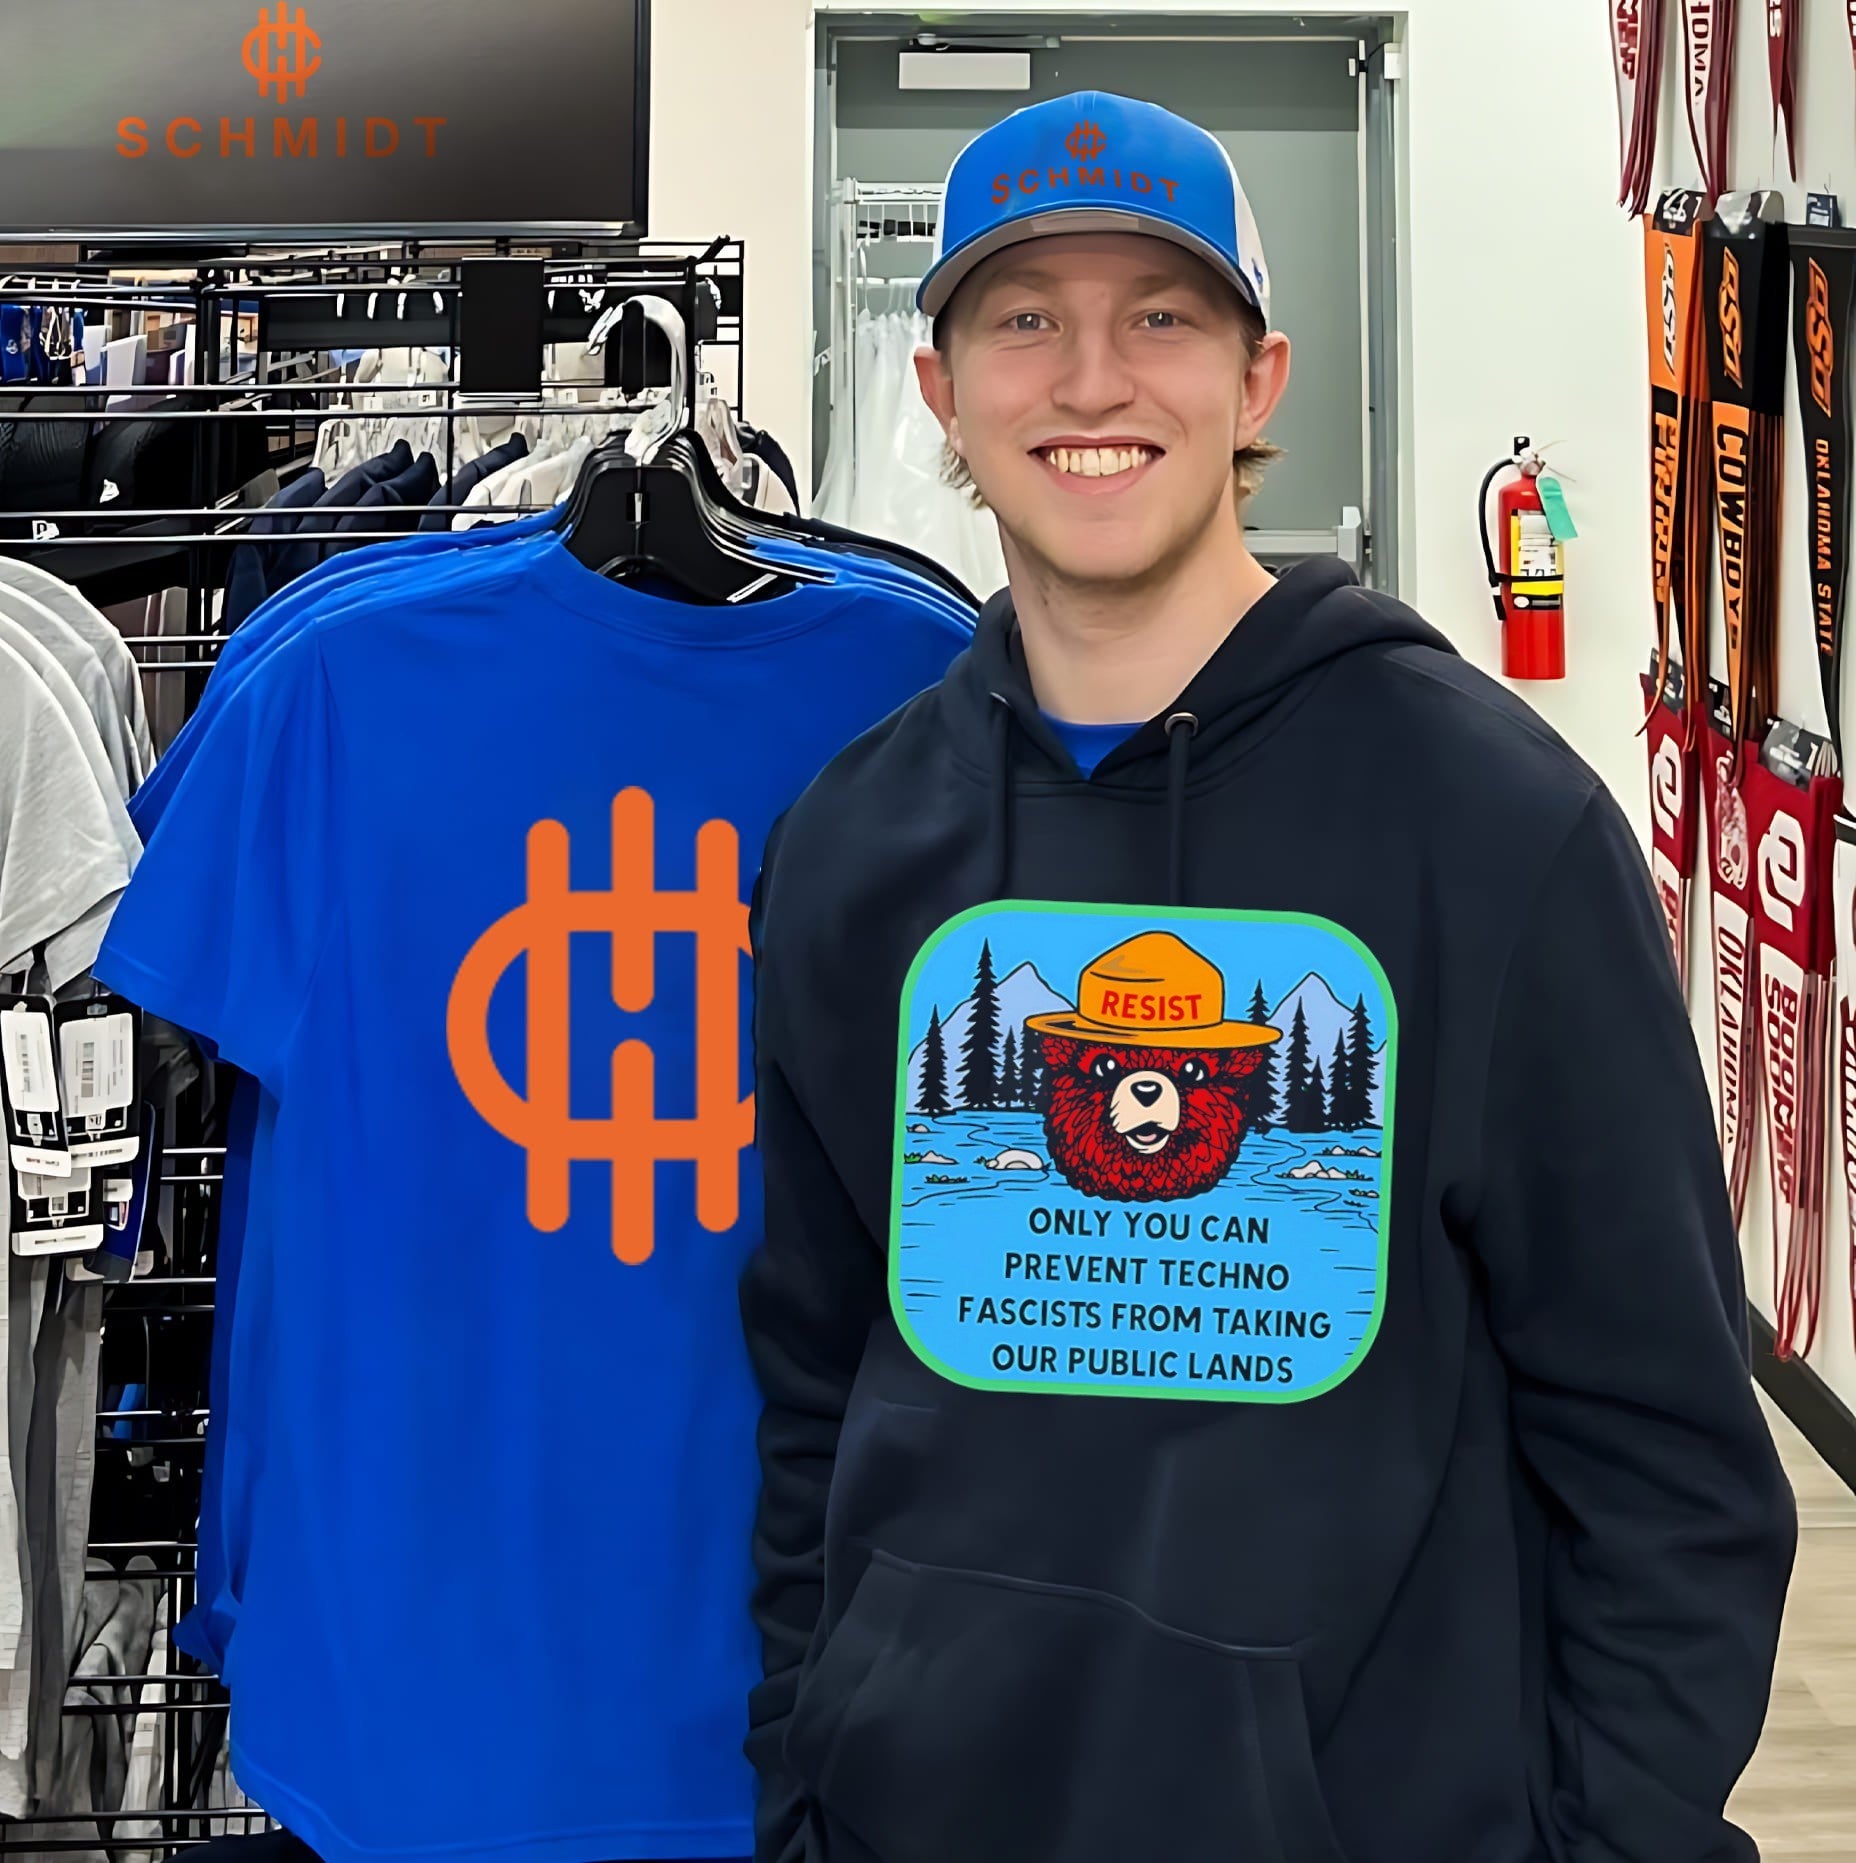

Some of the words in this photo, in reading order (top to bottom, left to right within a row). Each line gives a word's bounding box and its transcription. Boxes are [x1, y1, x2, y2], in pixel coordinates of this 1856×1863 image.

[115, 115, 448, 159] SCHMIDT
[991, 166, 1179, 204] SCHMIDT
[1816, 438, 1832, 570] OKLAHOMA
[1100, 990, 1202, 1022] RESIST
[1779, 984, 1799, 1203] BOOM
[1029, 1207, 1112, 1237] ONLY
[1123, 1211, 1190, 1241] YOU
[1200, 1215, 1269, 1244] CAN
[1005, 1252, 1149, 1285] PREVENT
[1158, 1259, 1290, 1291] TECHNO
[958, 1296, 1102, 1329] FASCISTS
[1112, 1302, 1202, 1334] FROM
[1212, 1307, 1331, 1339] TAKING
[992, 1343, 1057, 1373] OUR
[1068, 1347, 1179, 1379] PUBLIC
[1188, 1352, 1293, 1384] LANDS
